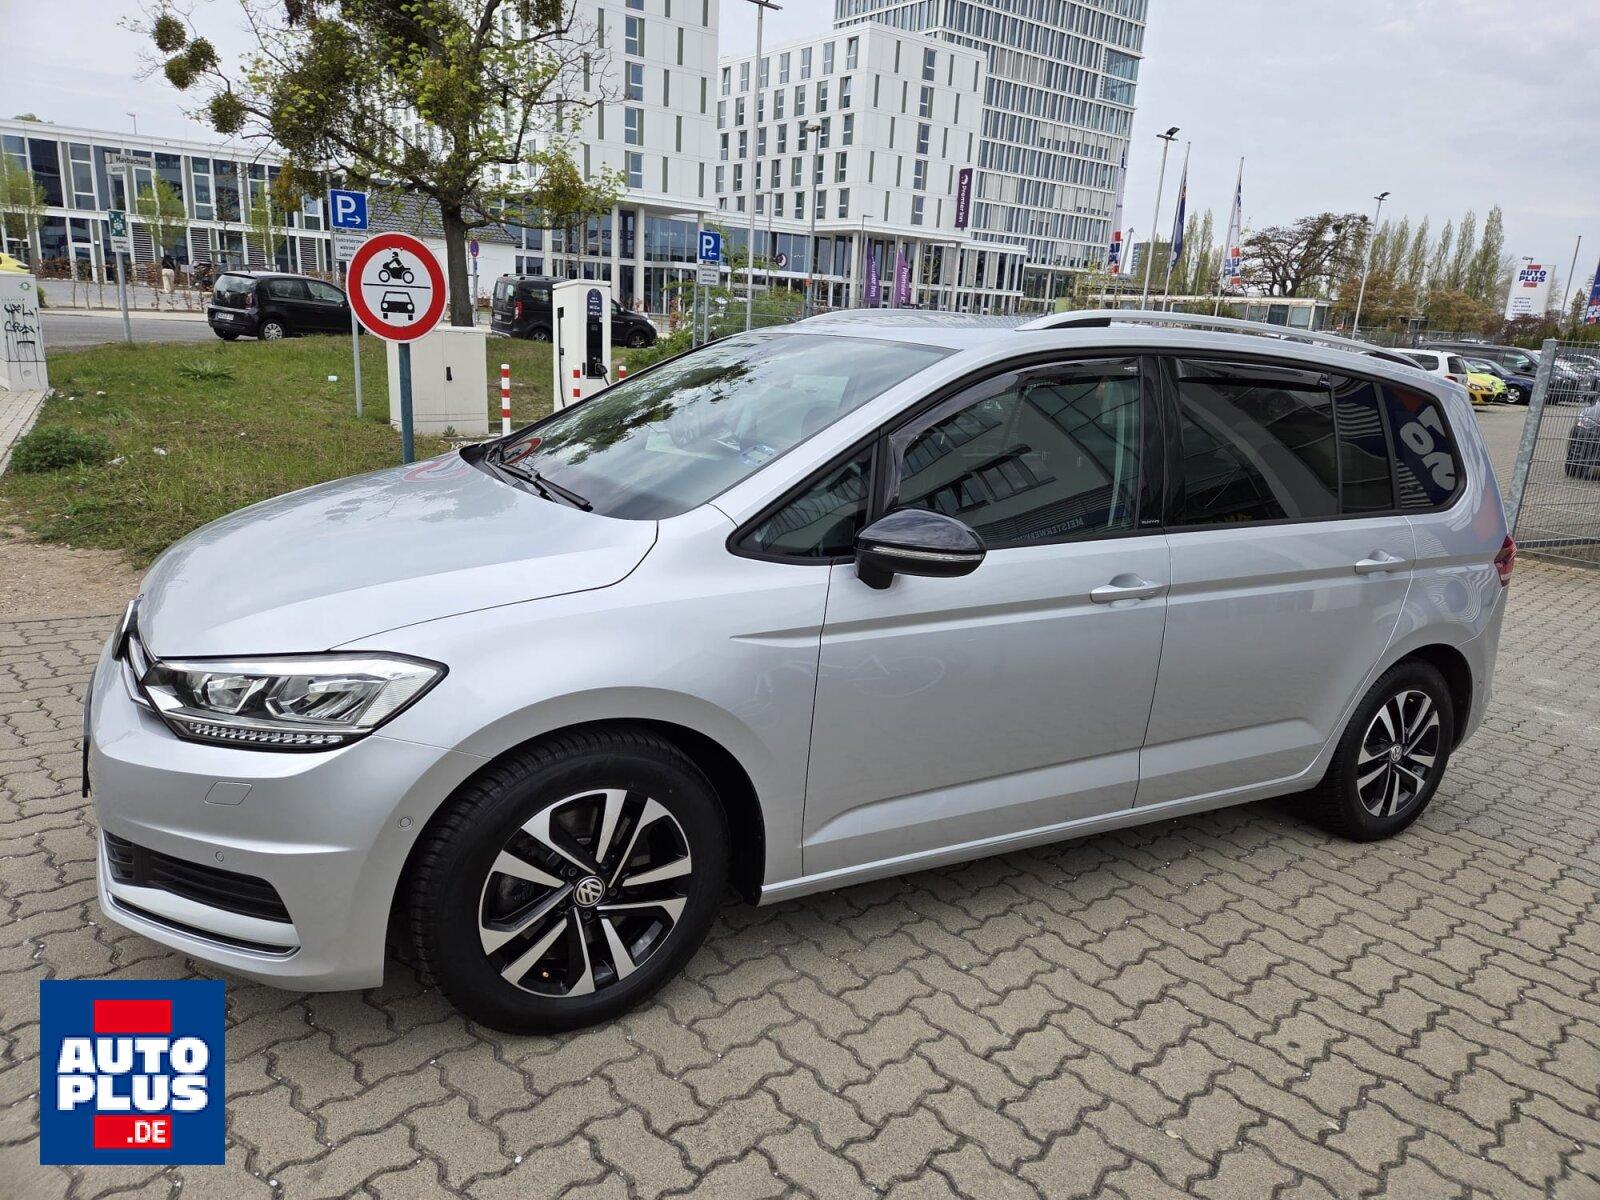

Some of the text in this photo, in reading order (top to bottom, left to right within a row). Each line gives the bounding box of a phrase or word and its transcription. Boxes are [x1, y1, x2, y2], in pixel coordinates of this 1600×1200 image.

[336, 195, 356, 223] P
[702, 235, 714, 257] P
[901, 267, 909, 296] Premier
[573, 876, 605, 907] VW
